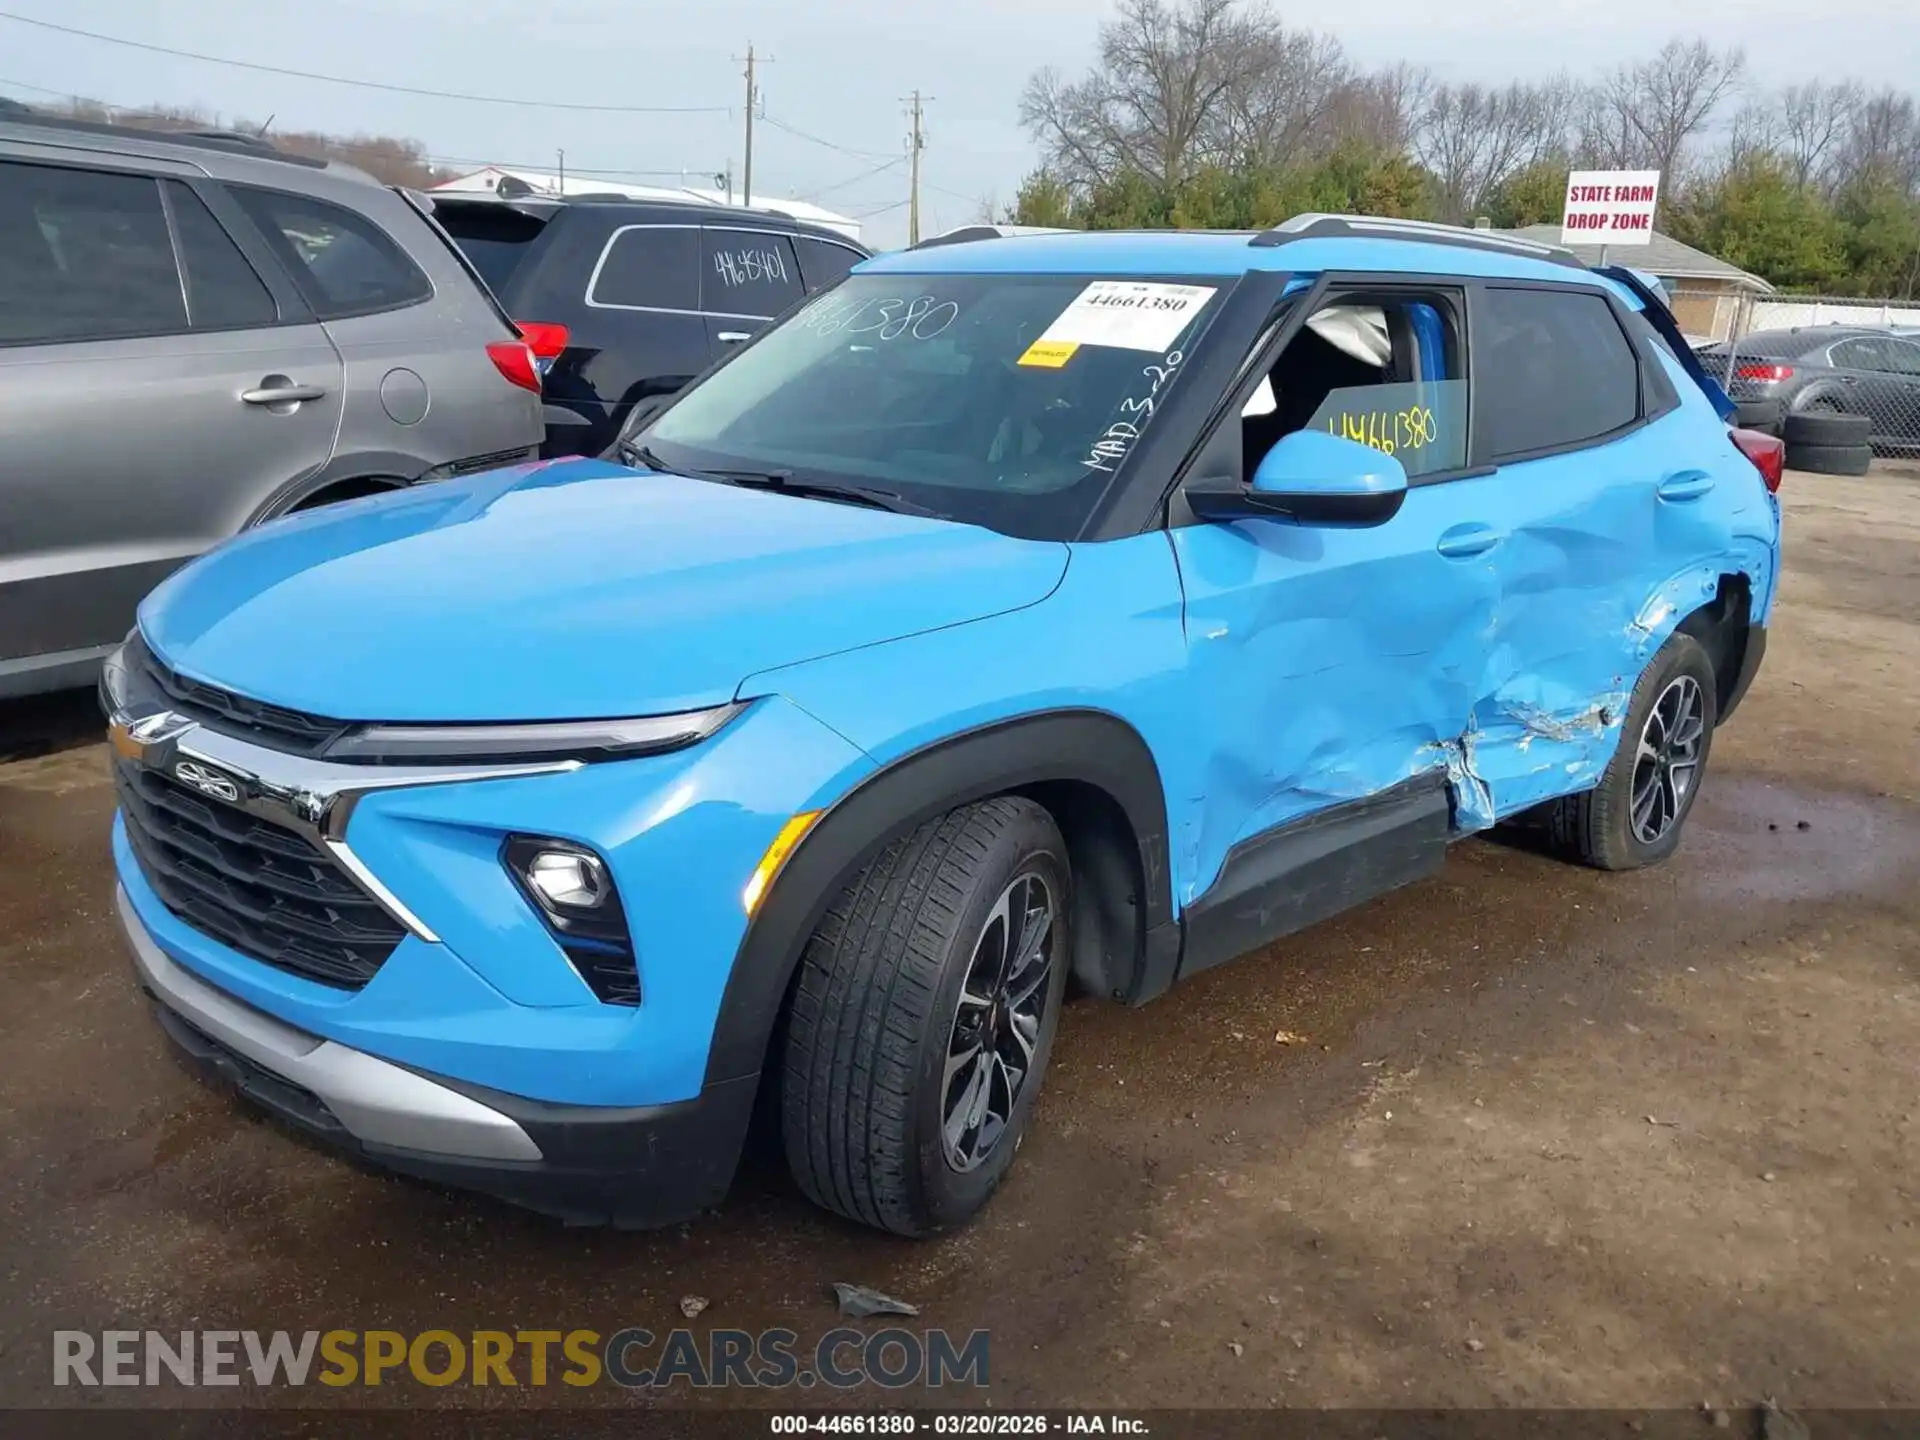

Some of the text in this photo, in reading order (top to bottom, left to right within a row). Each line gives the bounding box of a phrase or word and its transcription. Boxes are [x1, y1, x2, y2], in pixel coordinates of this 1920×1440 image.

[1570, 185, 1654, 202] STATE FARM
[1566, 213, 1650, 230] DROP ZONE
[1087, 293, 1188, 312] 44661380
[1081, 421, 1140, 471] MAD
